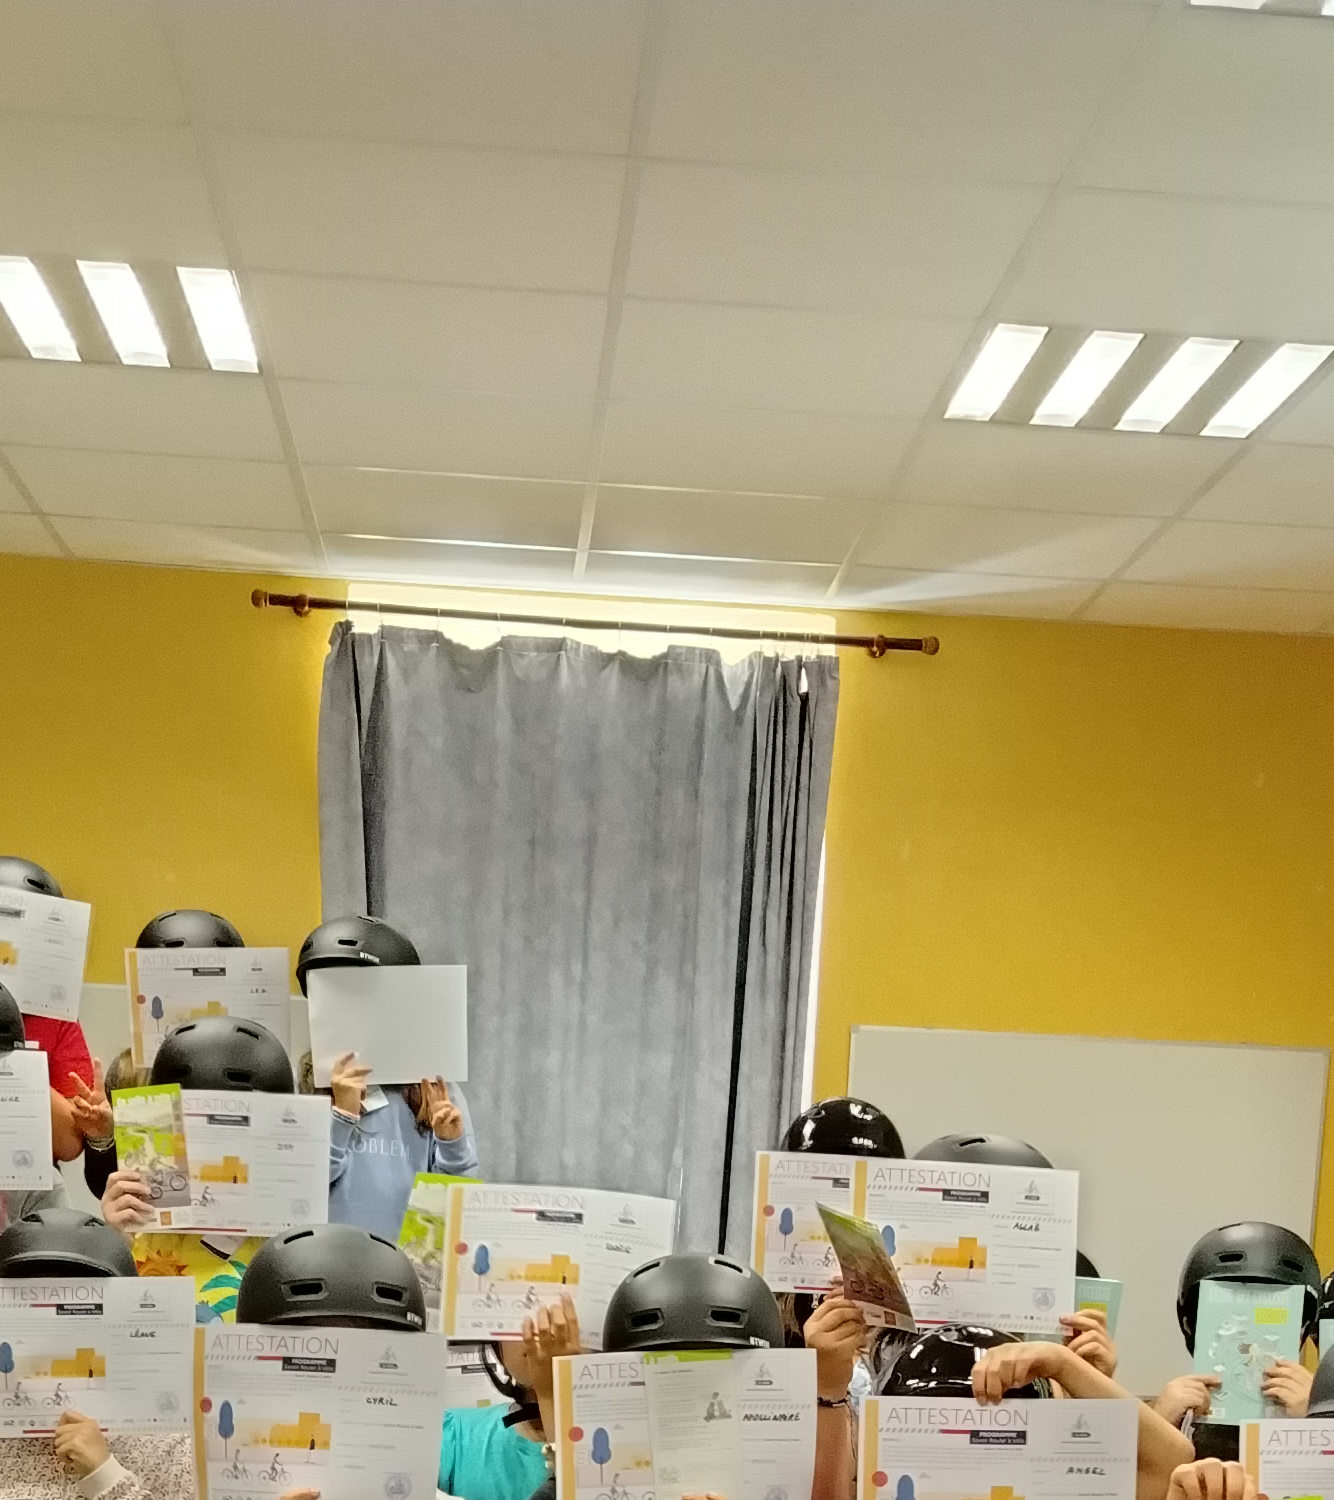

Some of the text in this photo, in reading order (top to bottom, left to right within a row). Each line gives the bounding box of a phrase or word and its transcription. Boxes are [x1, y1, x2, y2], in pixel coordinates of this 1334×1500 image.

[873, 1167, 992, 1189] ATTESTATION
[211, 1333, 339, 1355] ATTESTATION
[886, 1407, 1029, 1426] ATTESTATION
